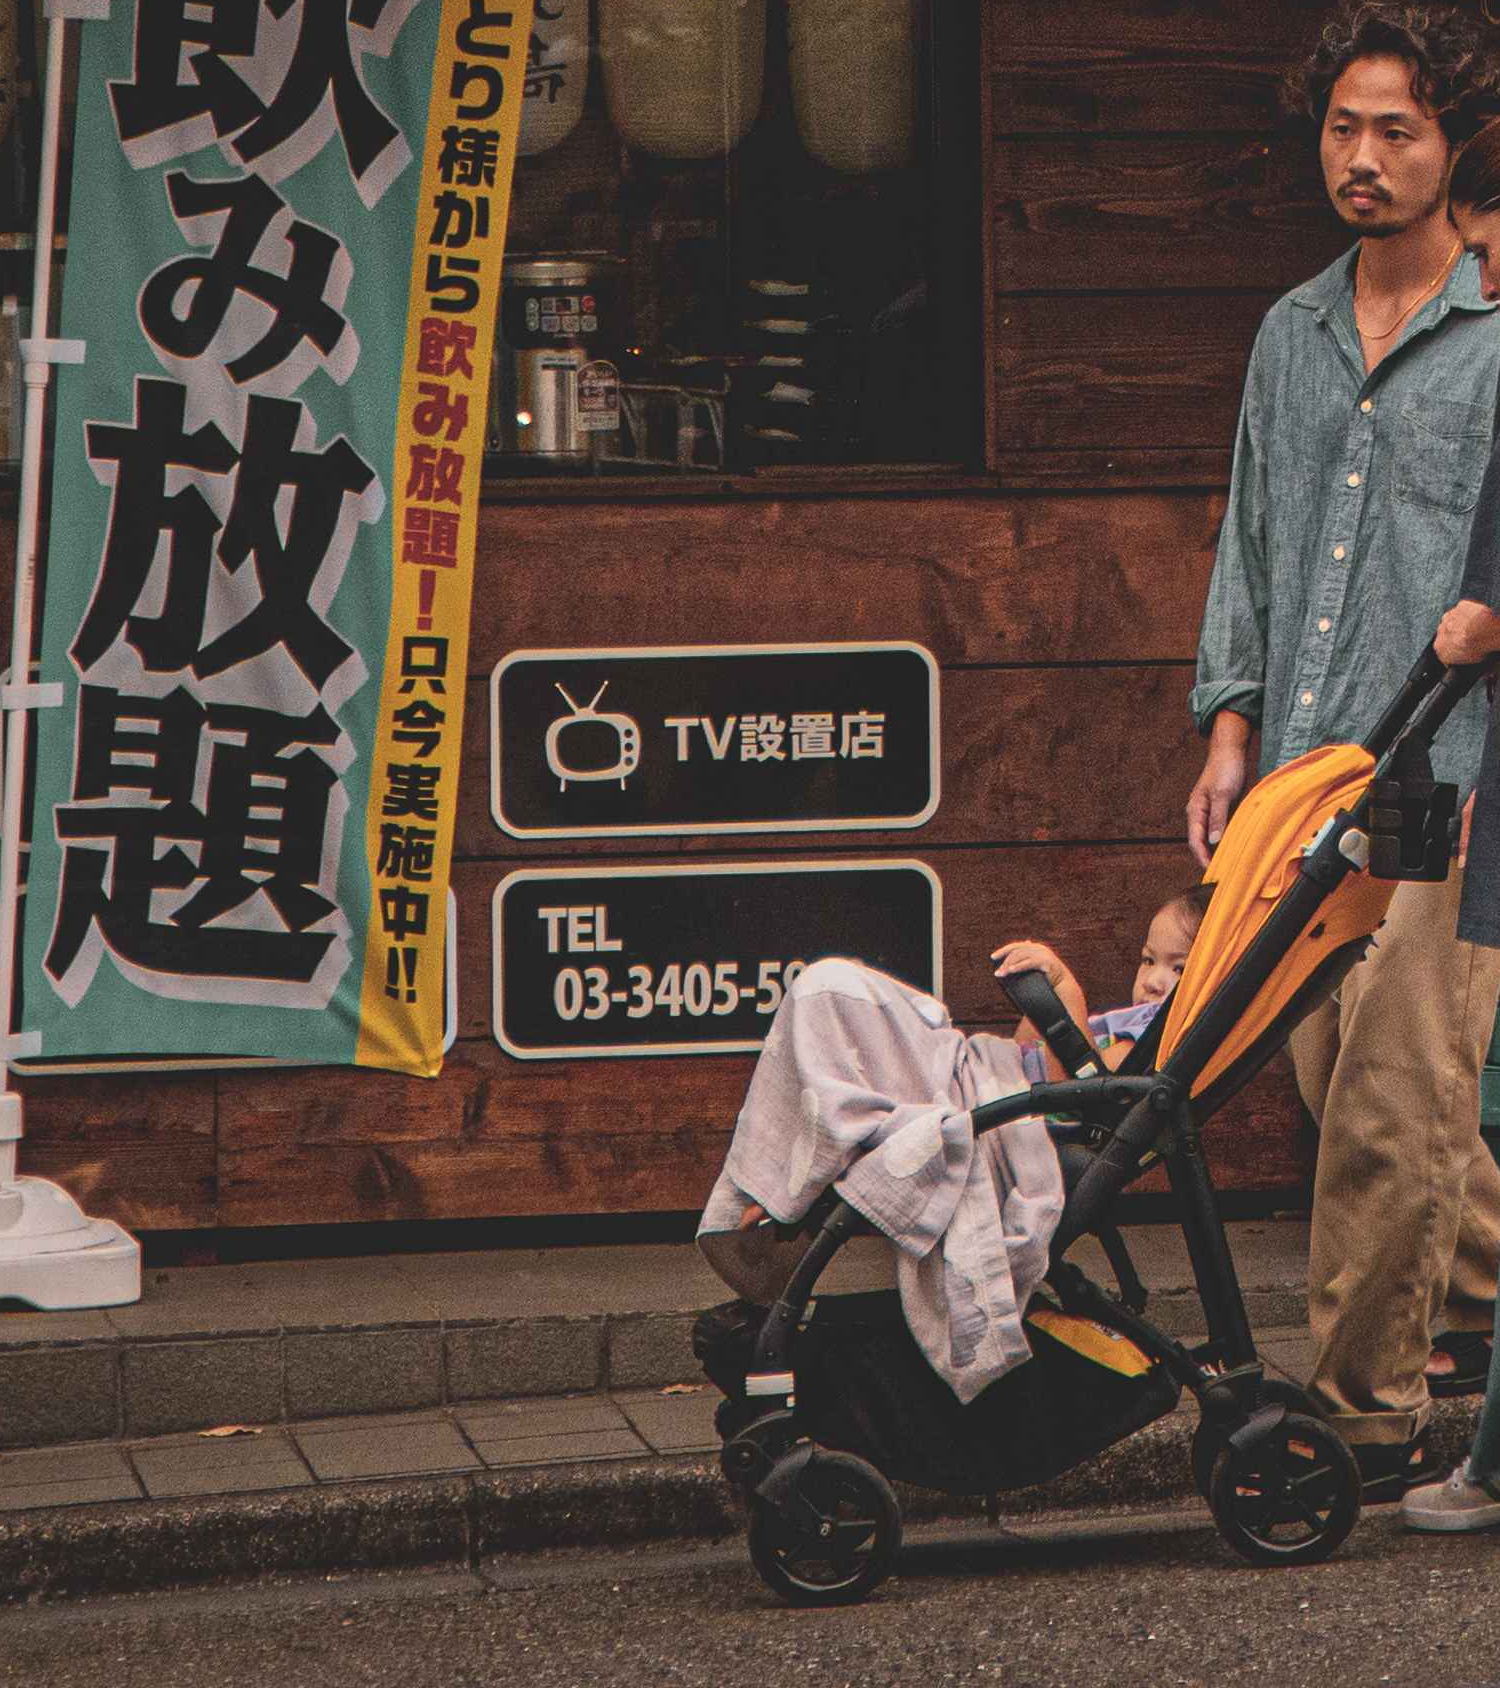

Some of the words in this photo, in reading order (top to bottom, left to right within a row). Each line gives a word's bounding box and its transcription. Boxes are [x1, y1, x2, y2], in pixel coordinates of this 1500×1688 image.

[664, 710, 887, 763] TV設置店
[538, 906, 623, 953] TEL
